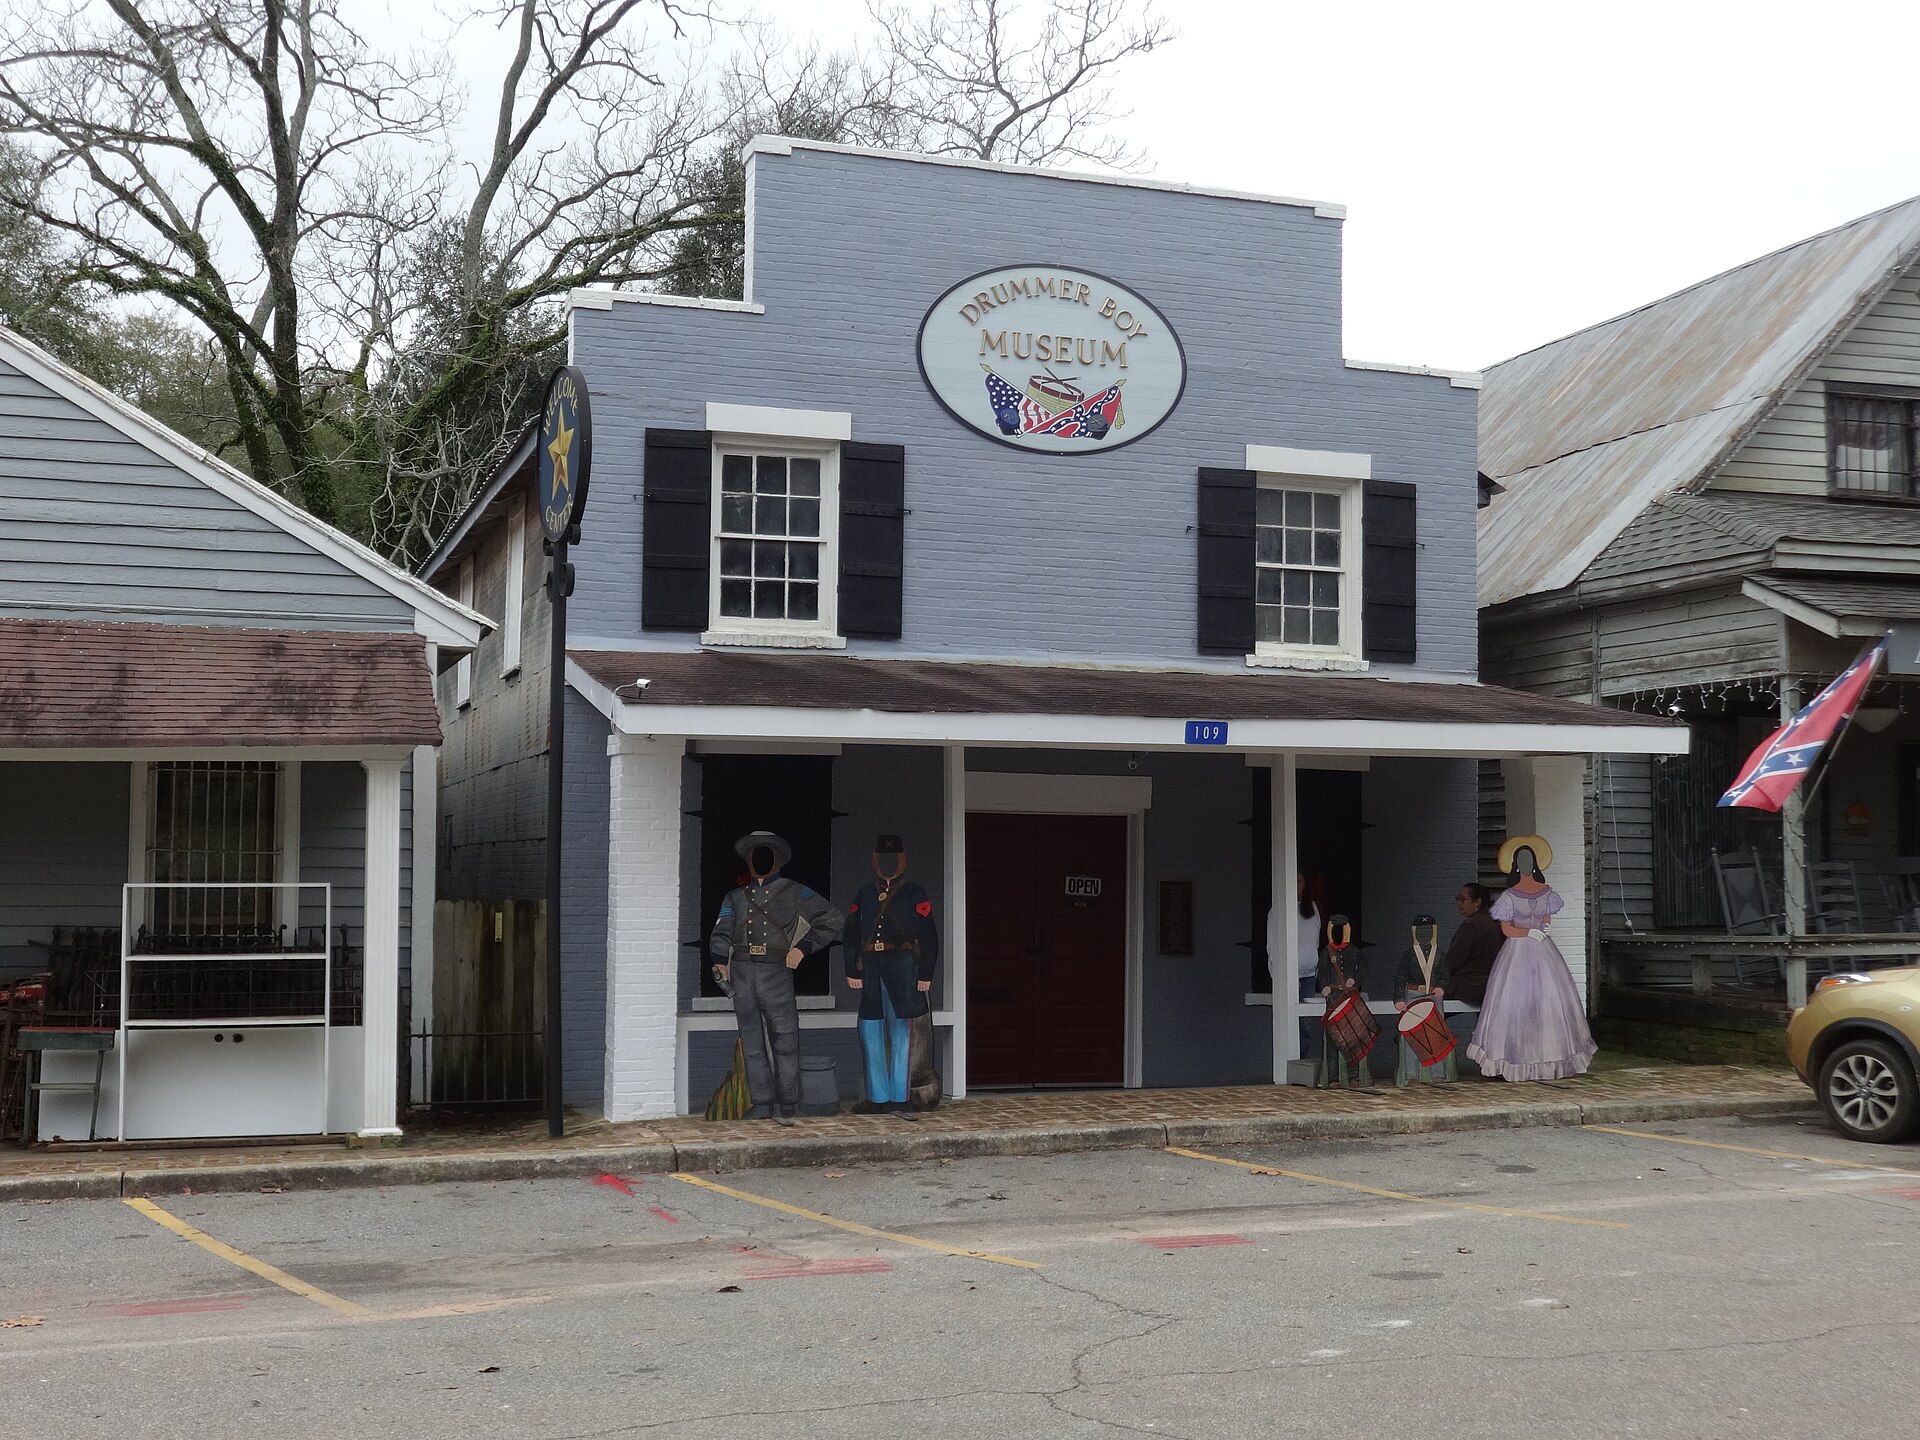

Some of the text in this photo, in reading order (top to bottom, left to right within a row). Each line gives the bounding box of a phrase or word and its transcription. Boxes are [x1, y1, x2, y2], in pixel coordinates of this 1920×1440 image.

[958, 276, 1149, 341] DRUMMER BOY
[979, 328, 1129, 369] MUSEUM
[543, 376, 578, 436] WELCOME
[545, 493, 574, 534] CENTER
[1195, 726, 1219, 740] 109
[1068, 878, 1099, 895] OPEN
[750, 946, 765, 954] CSA
